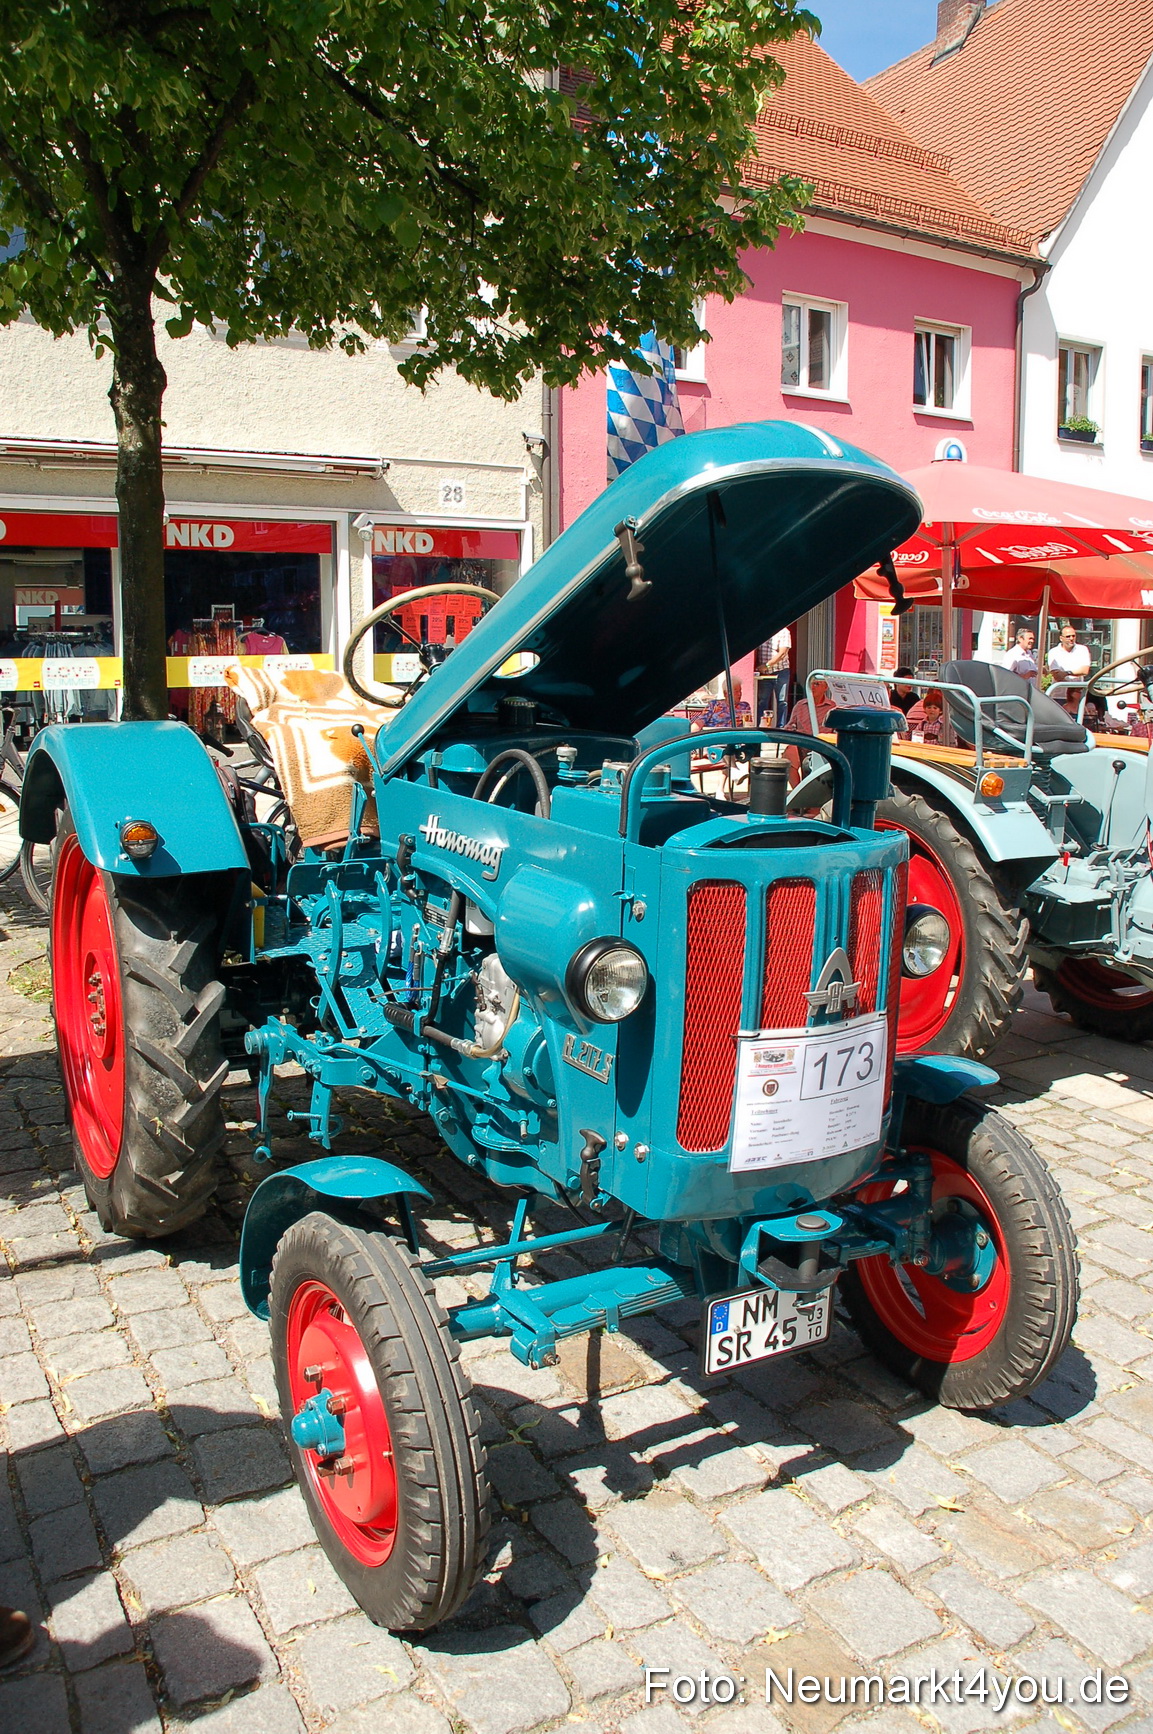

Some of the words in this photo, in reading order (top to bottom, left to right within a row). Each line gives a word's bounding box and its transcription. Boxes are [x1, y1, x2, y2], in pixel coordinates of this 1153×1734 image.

[442, 485, 463, 503] 28
[971, 507, 1062, 524] Coca-Cola
[166, 522, 235, 548] NKD
[374, 530, 434, 554] NKD
[16, 590, 59, 605] NKD
[858, 690, 884, 706] 149
[419, 814, 503, 881] Hanomag
[813, 1041, 874, 1091] 173
[742, 1290, 779, 1328] NM
[715, 1321, 724, 1333] D
[808, 1325, 822, 1340] 10
[716, 1330, 752, 1366] SR
[764, 1316, 798, 1350] 45
